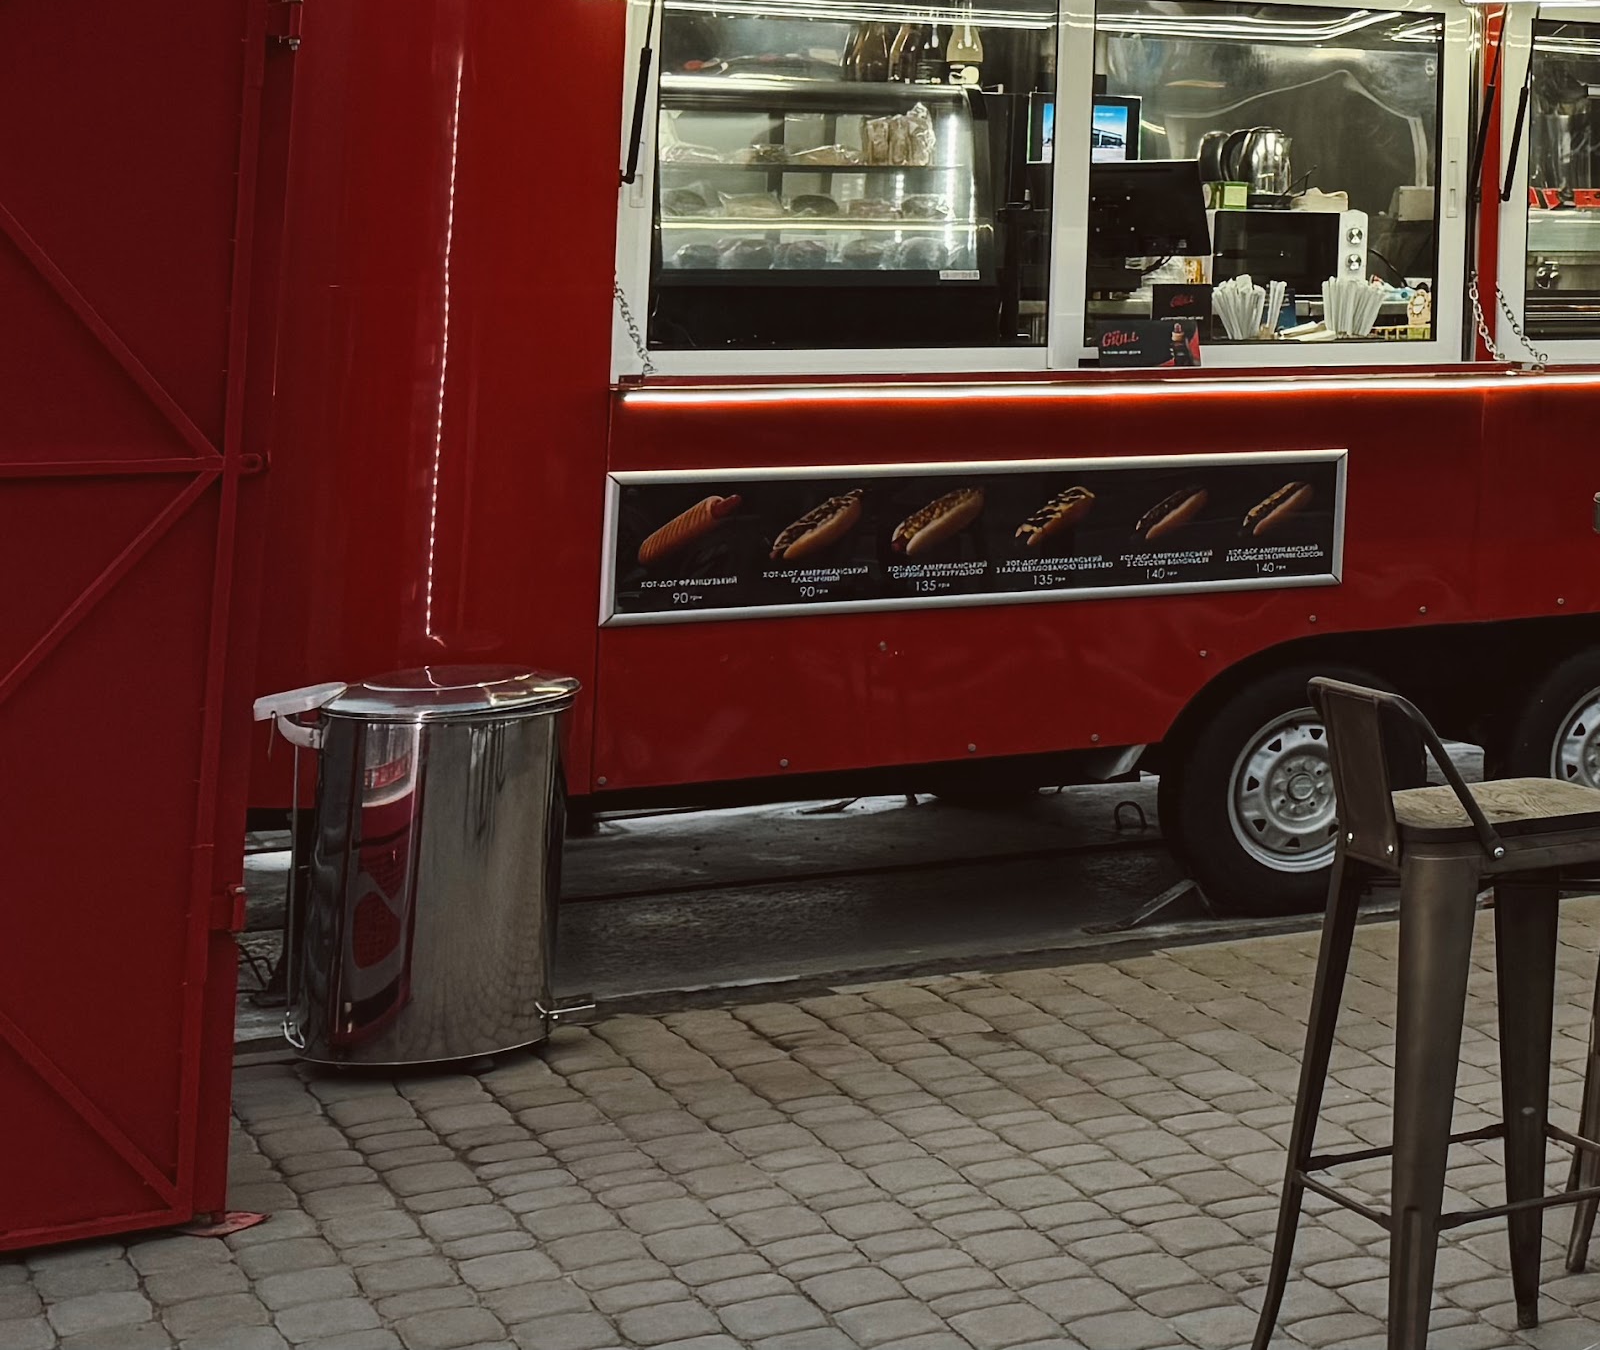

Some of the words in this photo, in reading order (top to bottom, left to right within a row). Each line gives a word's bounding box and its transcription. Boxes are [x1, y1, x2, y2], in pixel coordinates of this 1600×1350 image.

[1256, 562, 1275, 573] 140
[1033, 574, 1054, 586] 135
[1146, 568, 1166, 580] 140
[800, 586, 816, 598] 90
[915, 580, 937, 592] 135
[672, 592, 689, 604] 90
